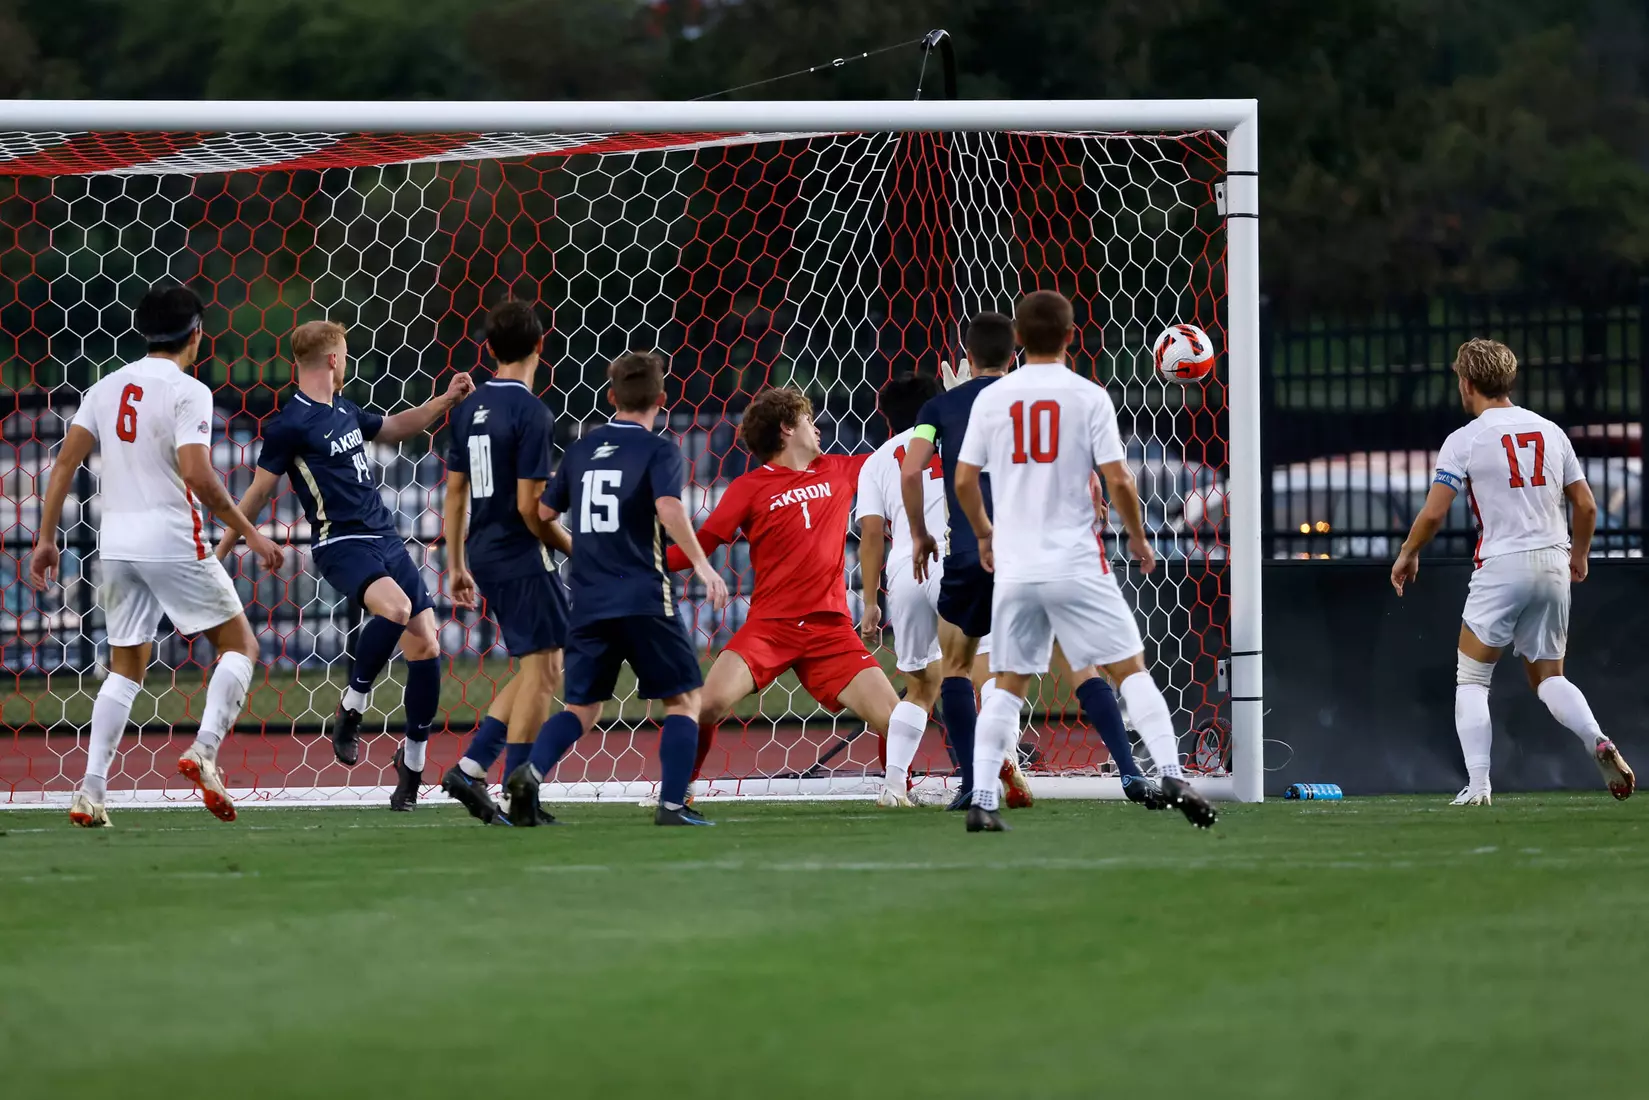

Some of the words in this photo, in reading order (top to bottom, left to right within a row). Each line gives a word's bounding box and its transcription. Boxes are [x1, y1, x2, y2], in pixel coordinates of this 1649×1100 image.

[116, 382, 144, 443] 6
[1009, 399, 1061, 464] 10
[351, 452, 371, 483] 14
[467, 434, 494, 498] 10
[1500, 431, 1546, 488] 17
[580, 469, 623, 533] 15
[769, 482, 832, 511] AKRON
[800, 501, 812, 529] 1
